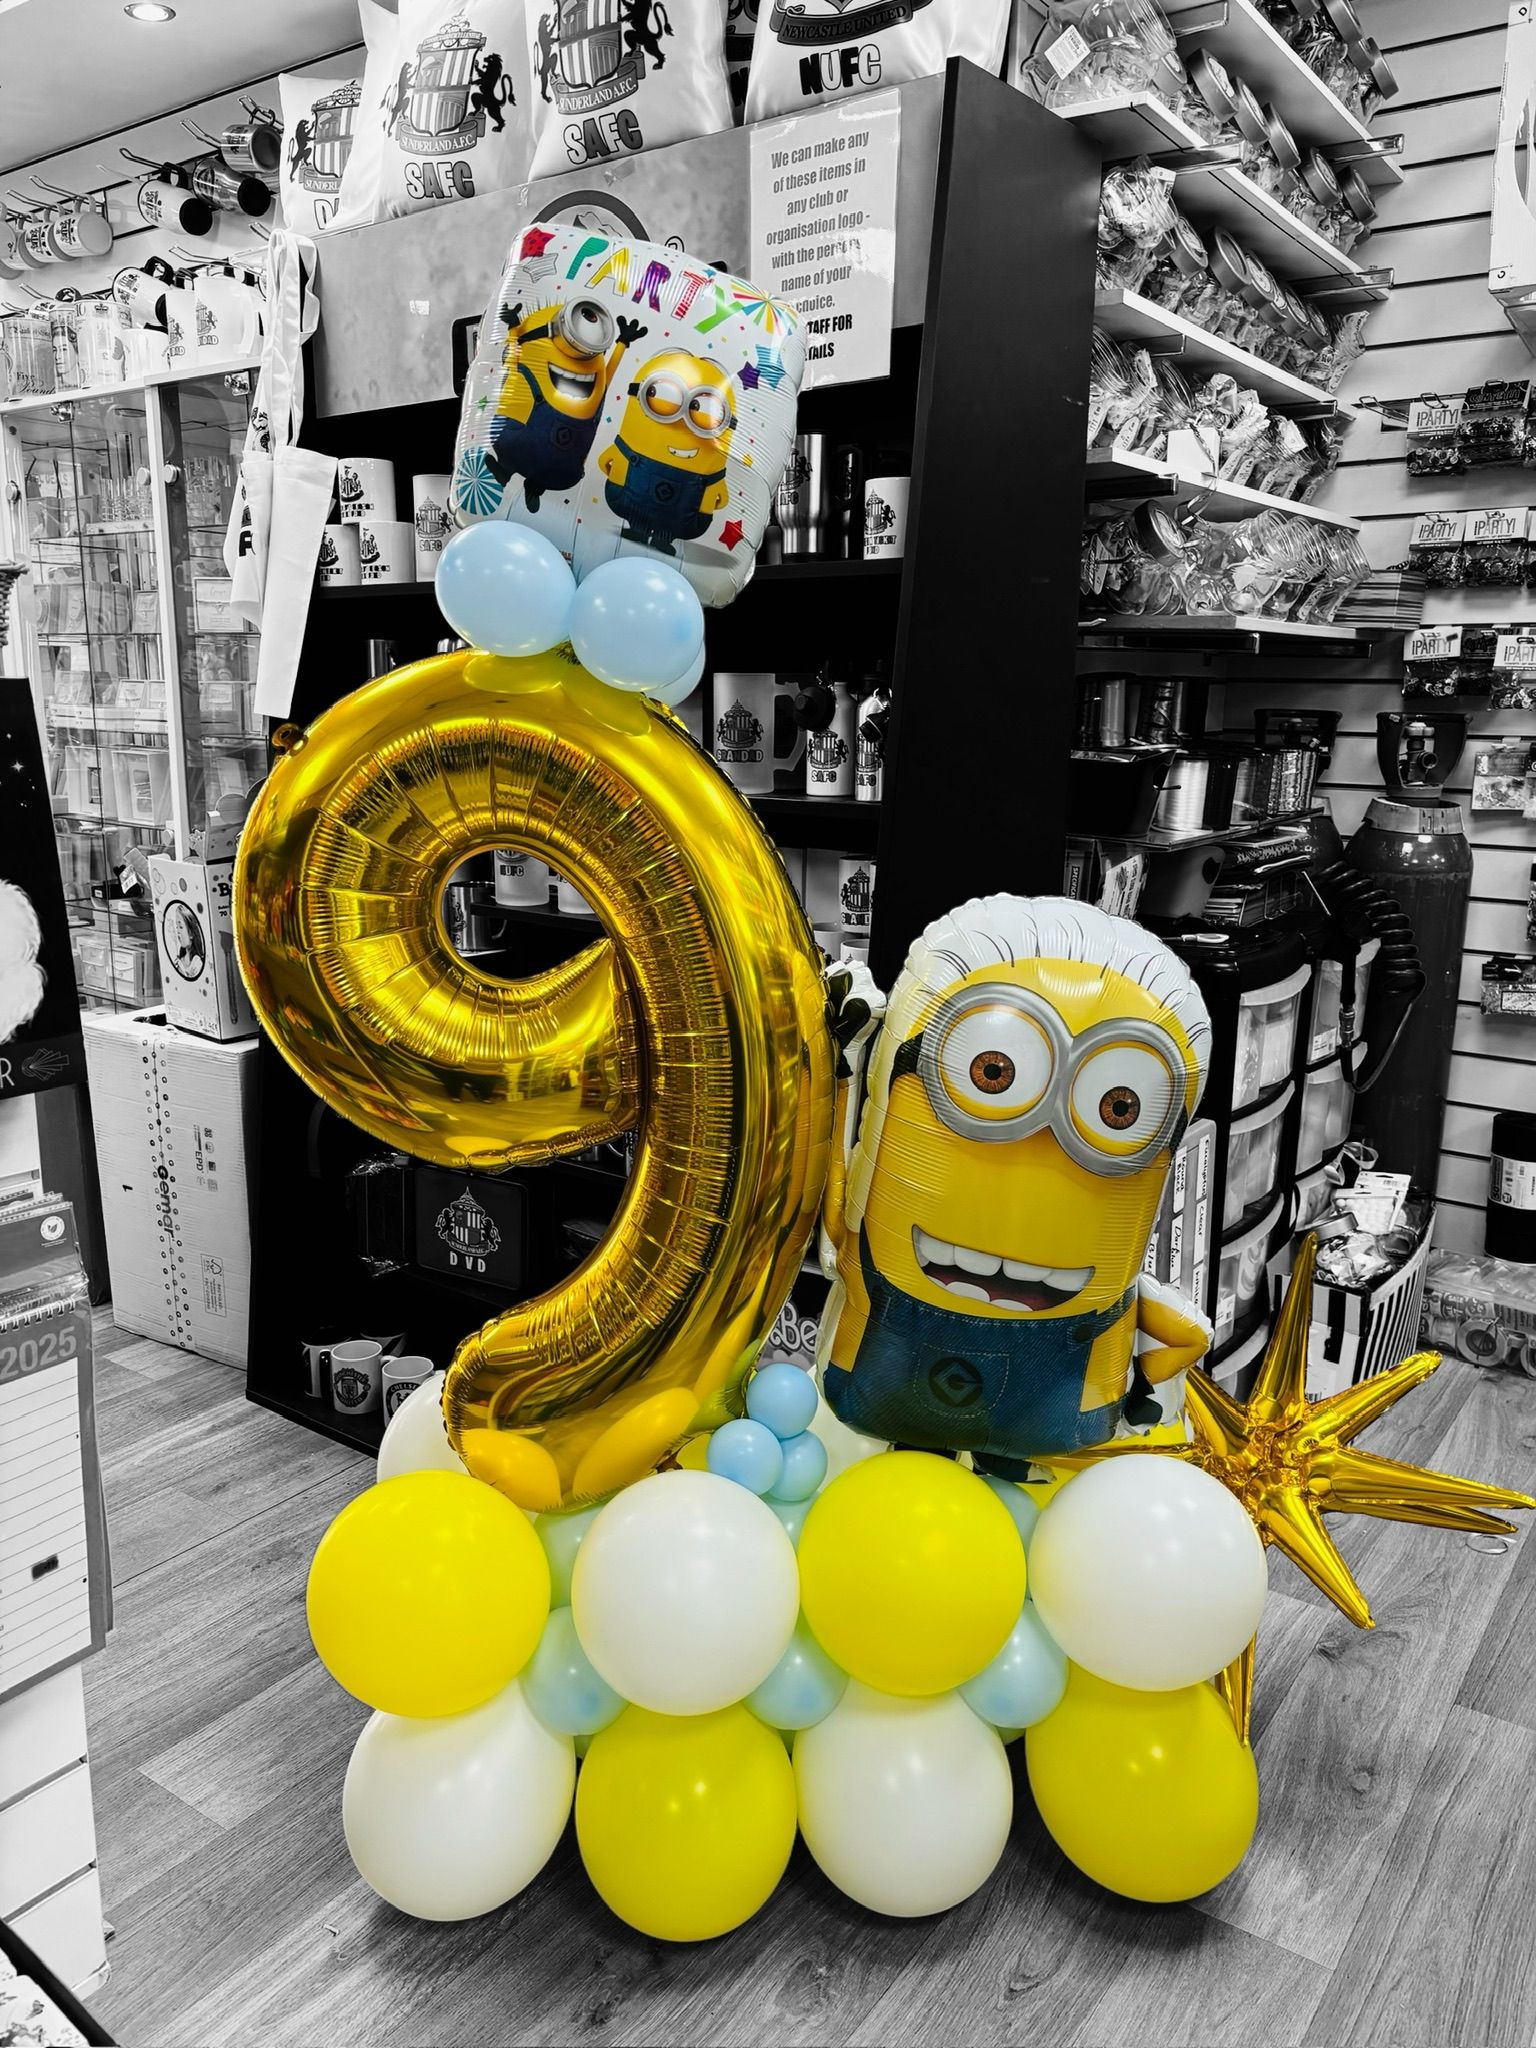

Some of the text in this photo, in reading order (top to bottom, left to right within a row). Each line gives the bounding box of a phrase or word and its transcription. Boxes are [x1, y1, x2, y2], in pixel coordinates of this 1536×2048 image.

[782, 5, 907, 39] NEWCASTLE UNITED
[799, 43, 882, 95] NUFC
[401, 137, 451, 151] SUNDERLAND
[563, 109, 643, 164] SAFC
[771, 131, 870, 169] We can make any
[404, 160, 475, 199] SAFC
[773, 157, 866, 194] of these items in
[314, 198, 340, 230] D
[787, 188, 849, 216] any club or
[766, 217, 836, 245] organisation
[838, 210, 864, 230] logo
[771, 250, 795, 269] with
[796, 247, 815, 265] the
[565, 236, 744, 335] PARTY
[781, 265, 852, 293] name of your
[806, 313, 853, 335] TAFF FOR
[805, 342, 834, 361] TAILS
[419, 539, 443, 552] SAFC
[716, 749, 763, 762] GRANDAD
[811, 771, 837, 782] SAFC
[157, 1165, 174, 1239] Gemar
[0, 1326, 77, 1380] 2025
